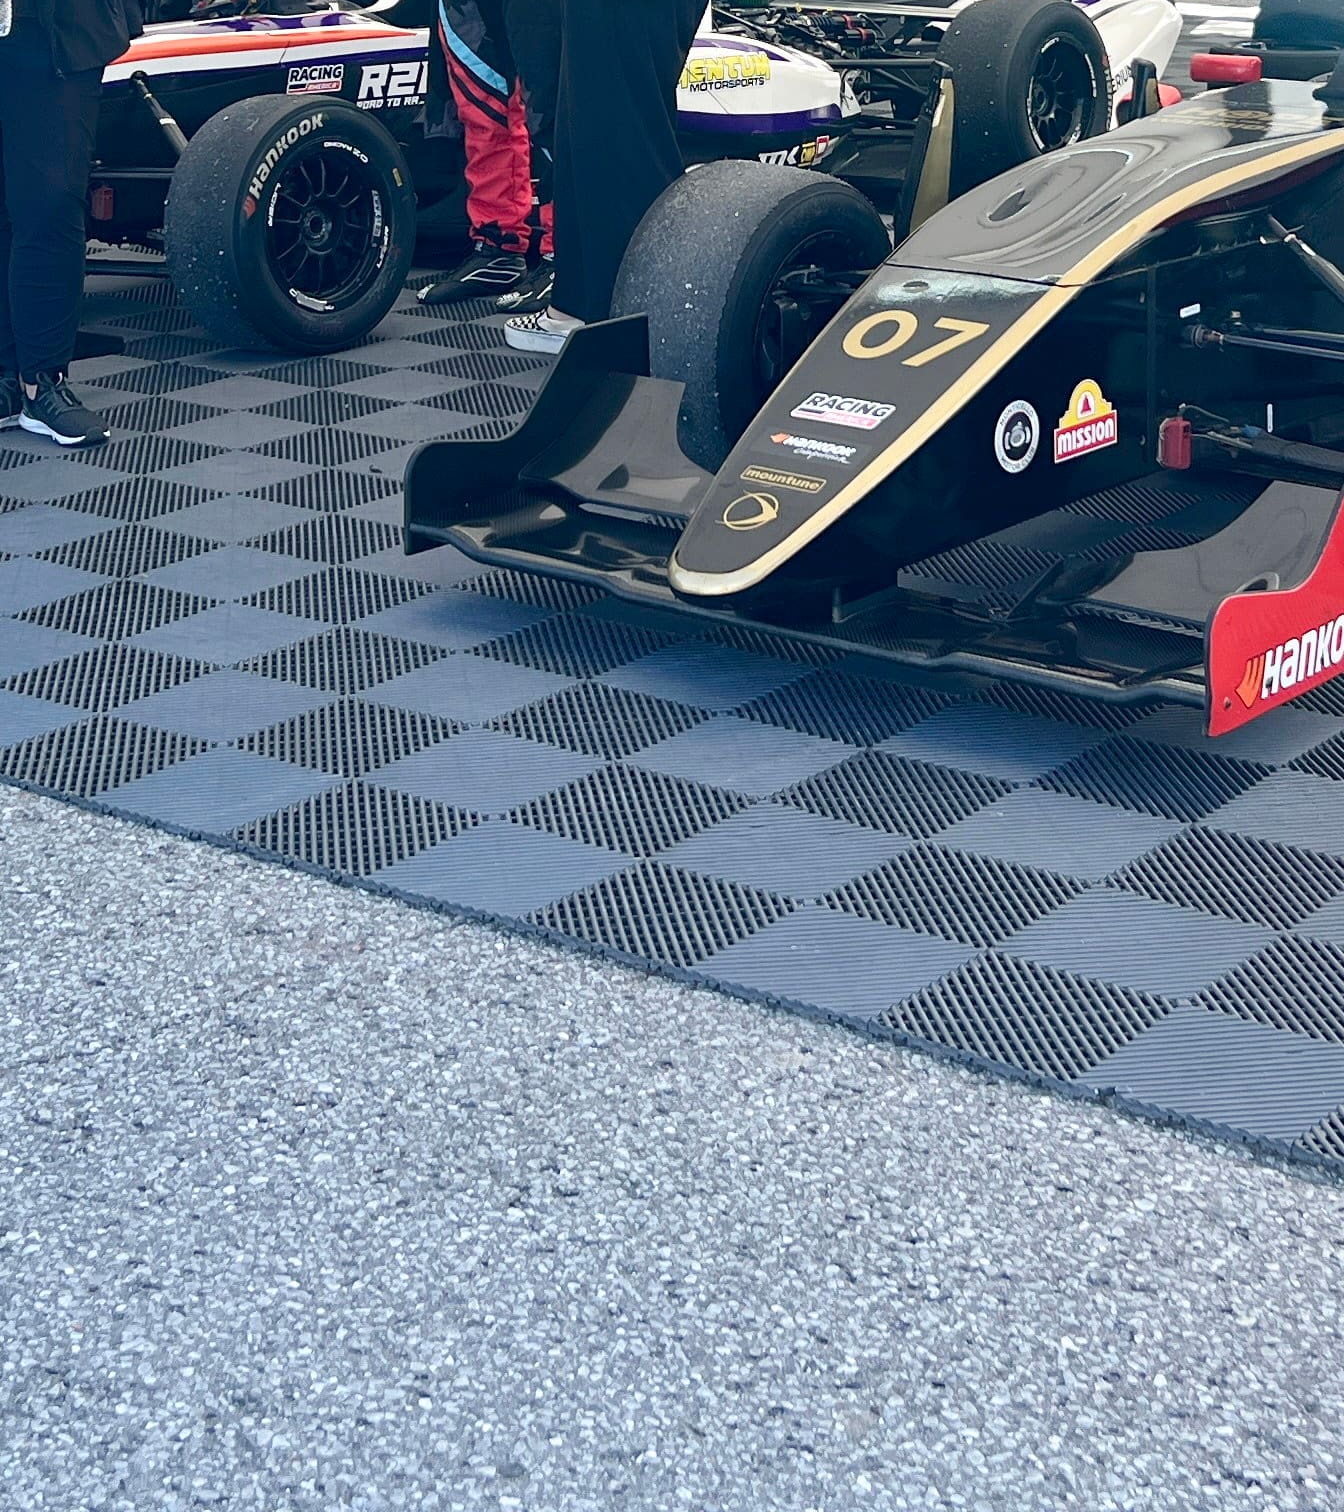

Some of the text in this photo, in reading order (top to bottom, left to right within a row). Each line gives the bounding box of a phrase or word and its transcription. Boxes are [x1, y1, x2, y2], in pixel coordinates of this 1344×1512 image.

[290, 67, 342, 82] RACING
[681, 52, 771, 88] ENTUM
[690, 77, 764, 92] MOTORSPORTS
[387, 98, 401, 107] TO
[842, 309, 990, 367] 07
[806, 395, 890, 417] RACING
[745, 467, 821, 491] mountune
